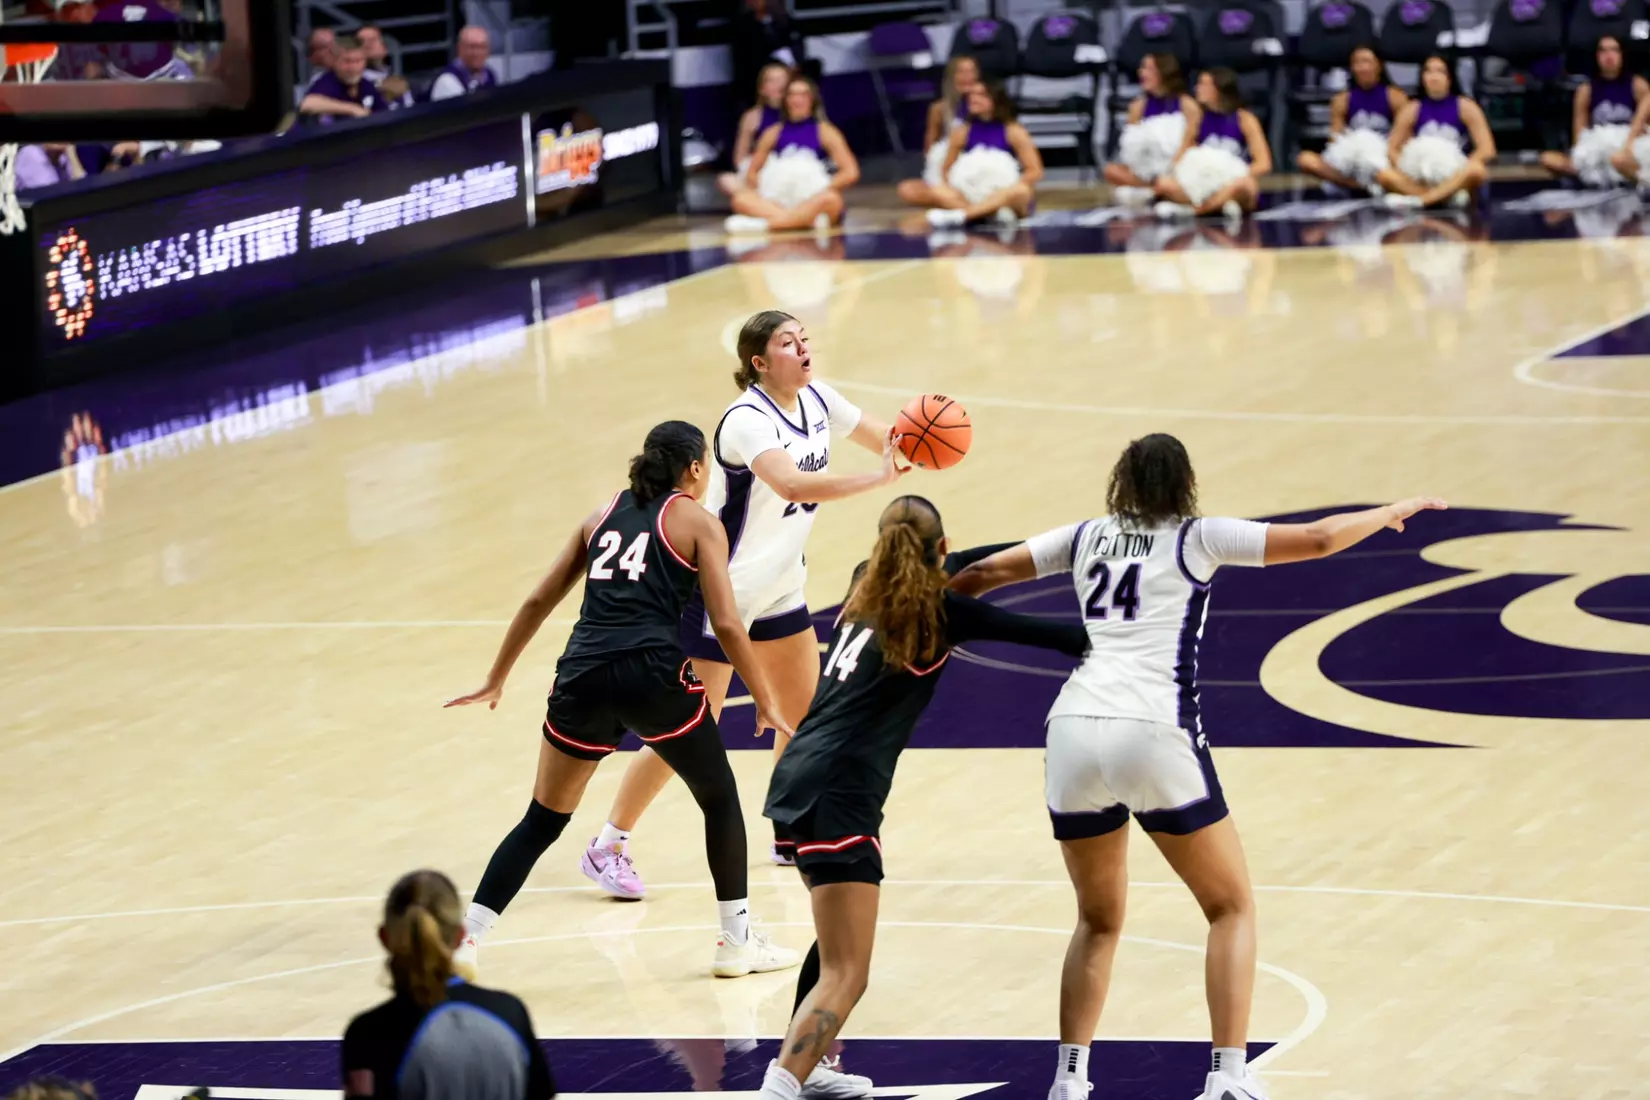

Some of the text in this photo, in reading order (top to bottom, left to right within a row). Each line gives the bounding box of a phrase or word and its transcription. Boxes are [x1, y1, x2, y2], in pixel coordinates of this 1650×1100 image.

[97, 232, 196, 300] KANSAS
[588, 530, 651, 581] 24
[1085, 562, 1142, 621] 24
[823, 621, 875, 682] 14
